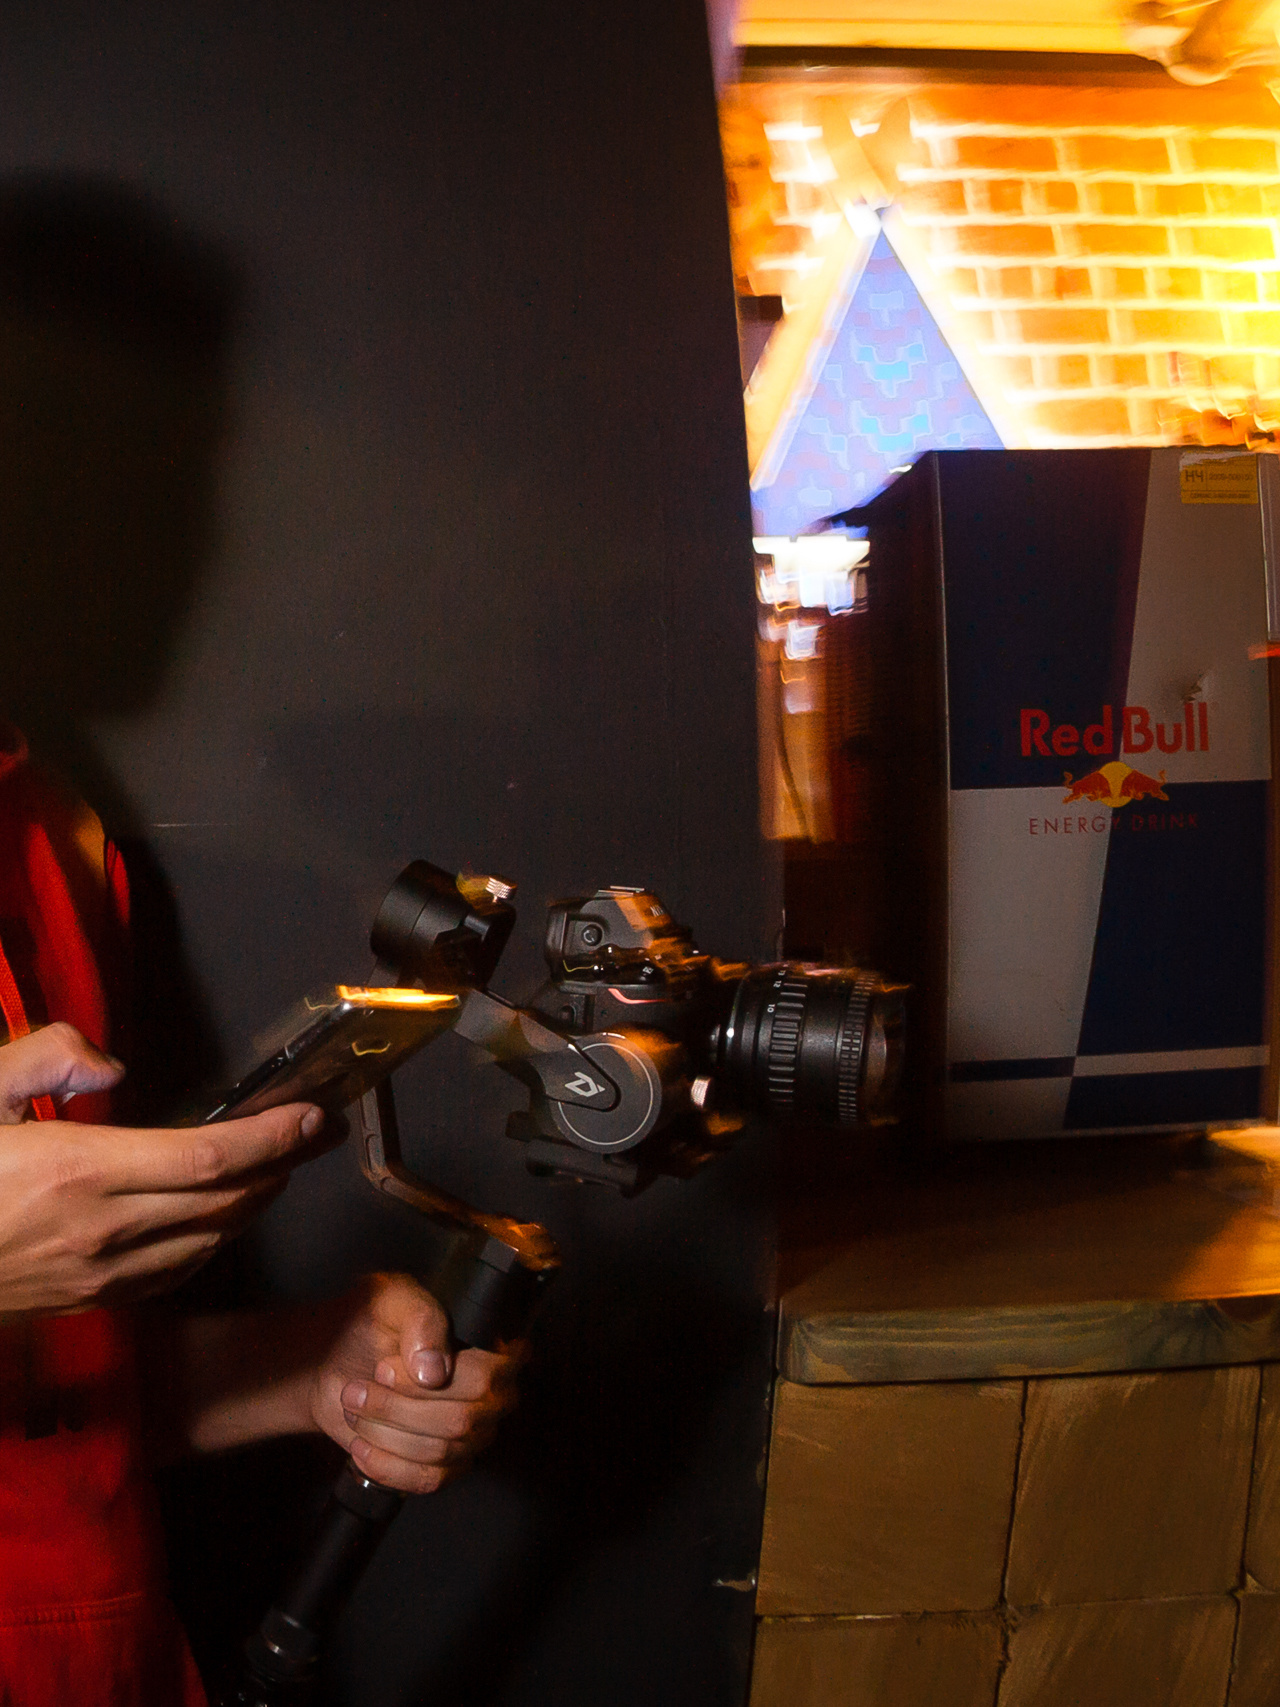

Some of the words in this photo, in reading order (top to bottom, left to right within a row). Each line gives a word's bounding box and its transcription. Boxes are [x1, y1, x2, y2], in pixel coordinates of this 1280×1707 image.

[1020, 704, 1113, 757] Red
[1122, 702, 1209, 754] Bull
[1029, 815, 1121, 835] ENERGY
[1132, 812, 1199, 832] DRINK
